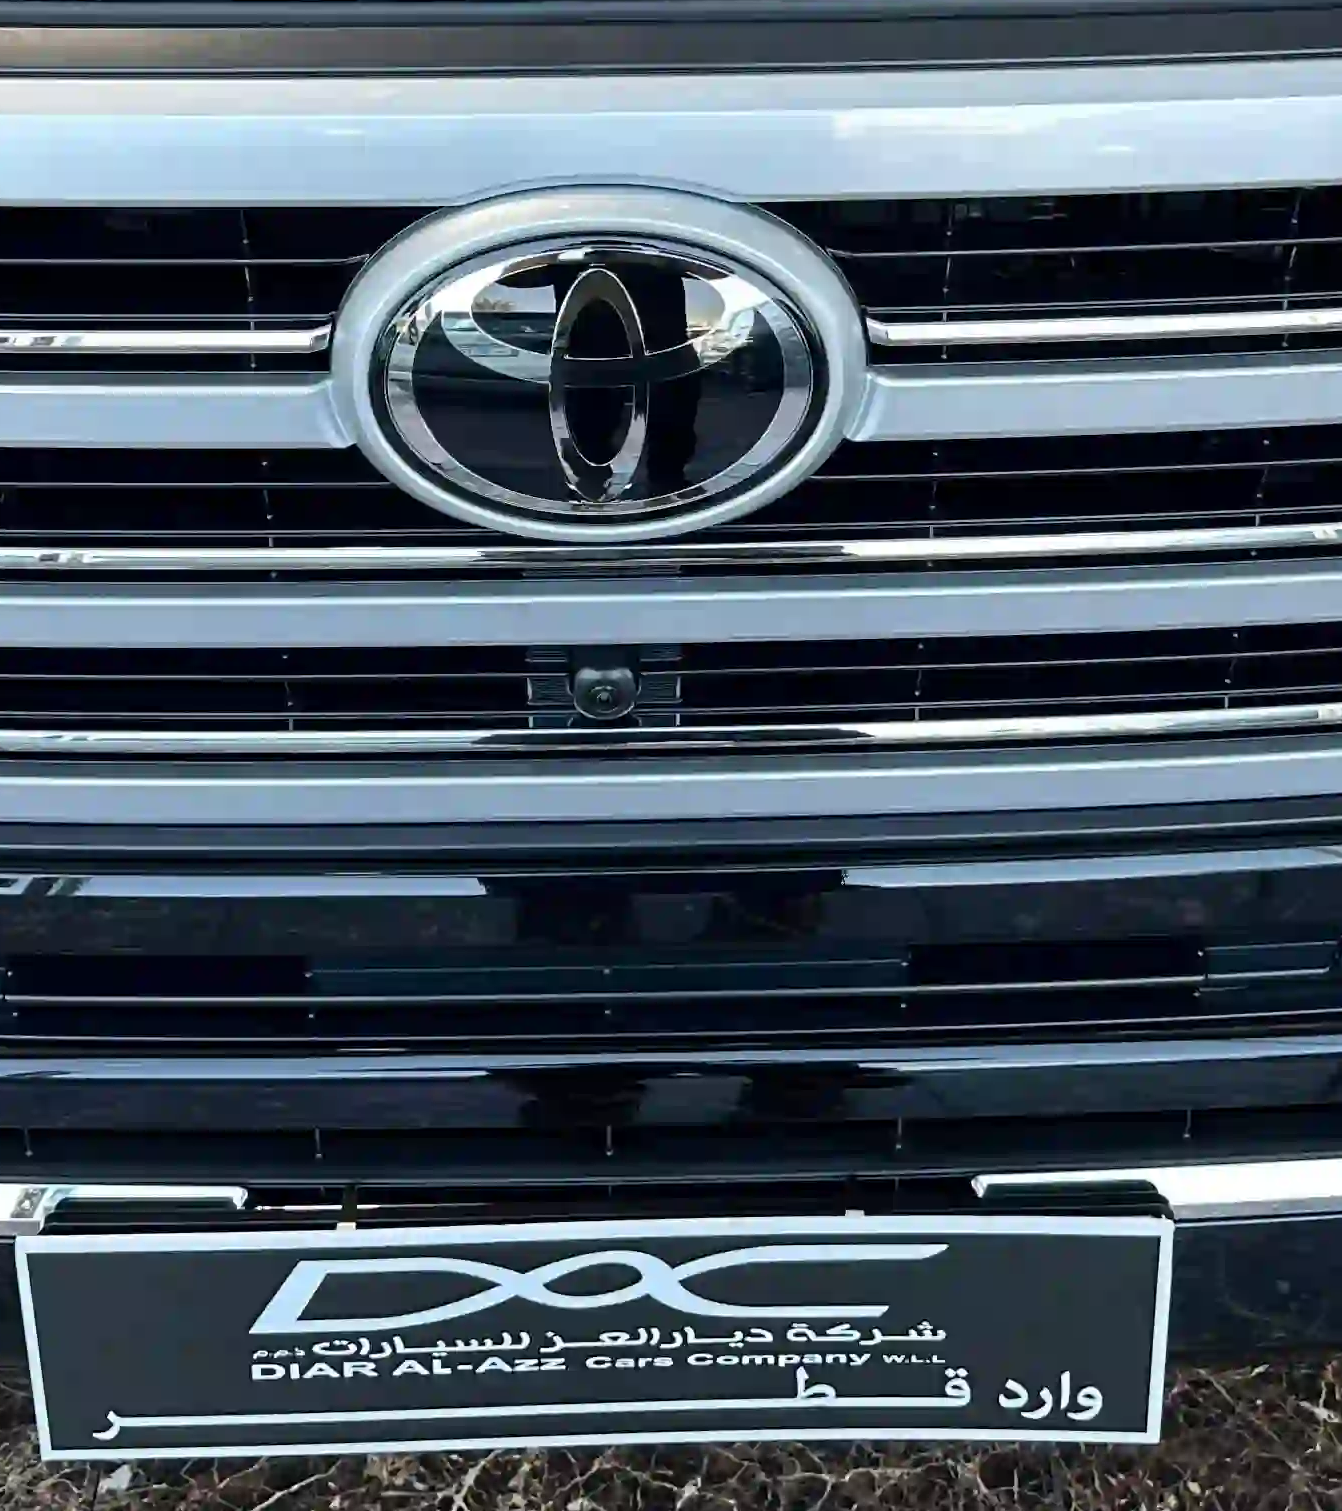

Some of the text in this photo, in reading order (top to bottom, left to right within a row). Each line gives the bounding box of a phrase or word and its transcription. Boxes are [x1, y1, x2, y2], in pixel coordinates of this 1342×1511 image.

[311, 1330, 532, 1359] للسيارات
[539, 1326, 661, 1354] العز
[659, 1326, 774, 1349] ديار
[785, 1320, 947, 1346] شركة
[250, 1360, 379, 1381] DIAR
[585, 1354, 675, 1370] Cars
[686, 1352, 871, 1368] Company
[997, 1370, 1104, 1421] وارد
